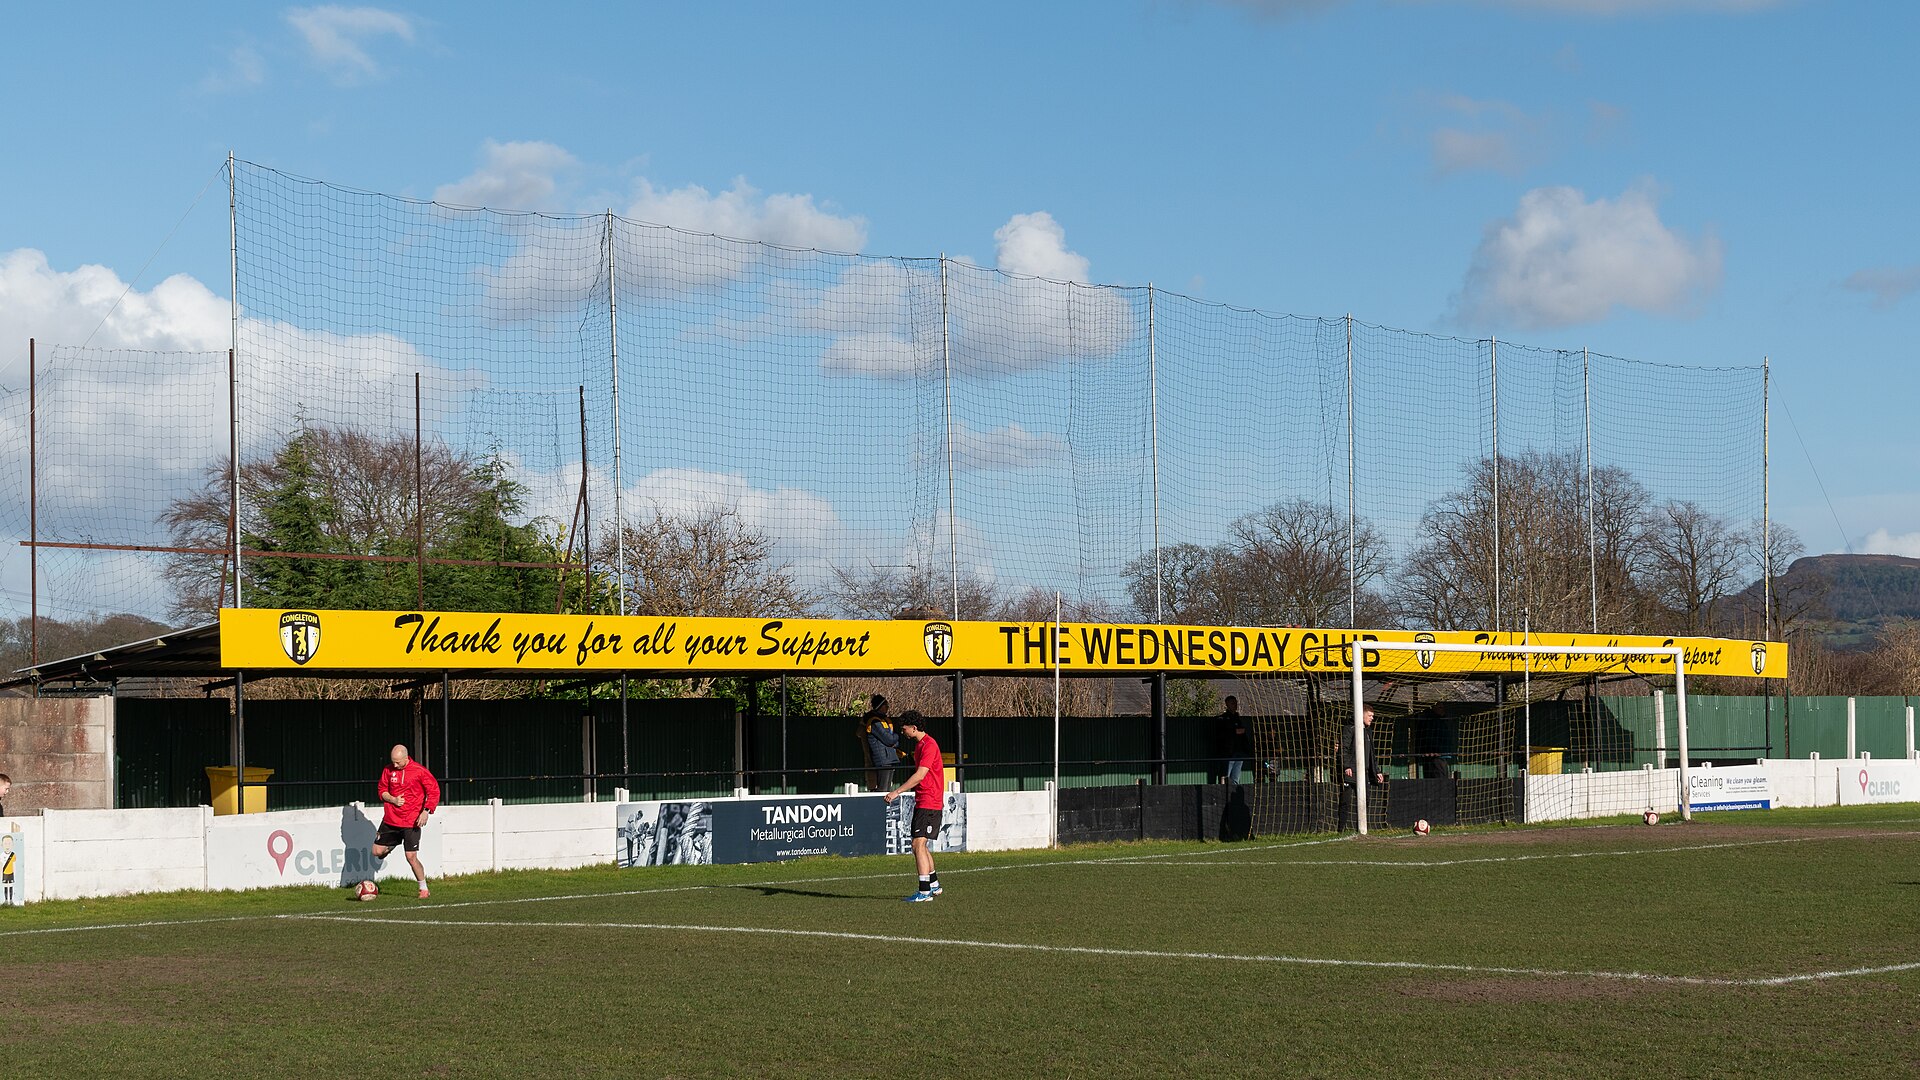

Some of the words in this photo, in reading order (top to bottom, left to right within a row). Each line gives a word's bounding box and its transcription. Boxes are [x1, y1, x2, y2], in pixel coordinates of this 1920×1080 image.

[281, 613, 318, 624] CONGLETON
[925, 623, 951, 633] CONGLETON
[395, 614, 502, 654] Thank
[513, 632, 567, 664] you
[576, 621, 623, 667] for
[633, 622, 675, 656] all
[684, 633, 748, 665] your
[757, 621, 871, 666] Support
[1000, 627, 1071, 664] THE
[1081, 628, 1291, 667] WEDNESDAY
[1301, 633, 1380, 667] CLUB
[1691, 776, 1723, 790] Cleaning
[1869, 780, 1901, 796] CLERIC
[1692, 790, 1711, 798] Services
[762, 804, 842, 824] TANDOM
[751, 827, 805, 842] Metallurgical
[808, 825, 836, 840] Group
[839, 824, 854, 837] Ltd
[776, 846, 827, 856] www.tandom.co.uk
[295, 847, 388, 876] CLERIC
